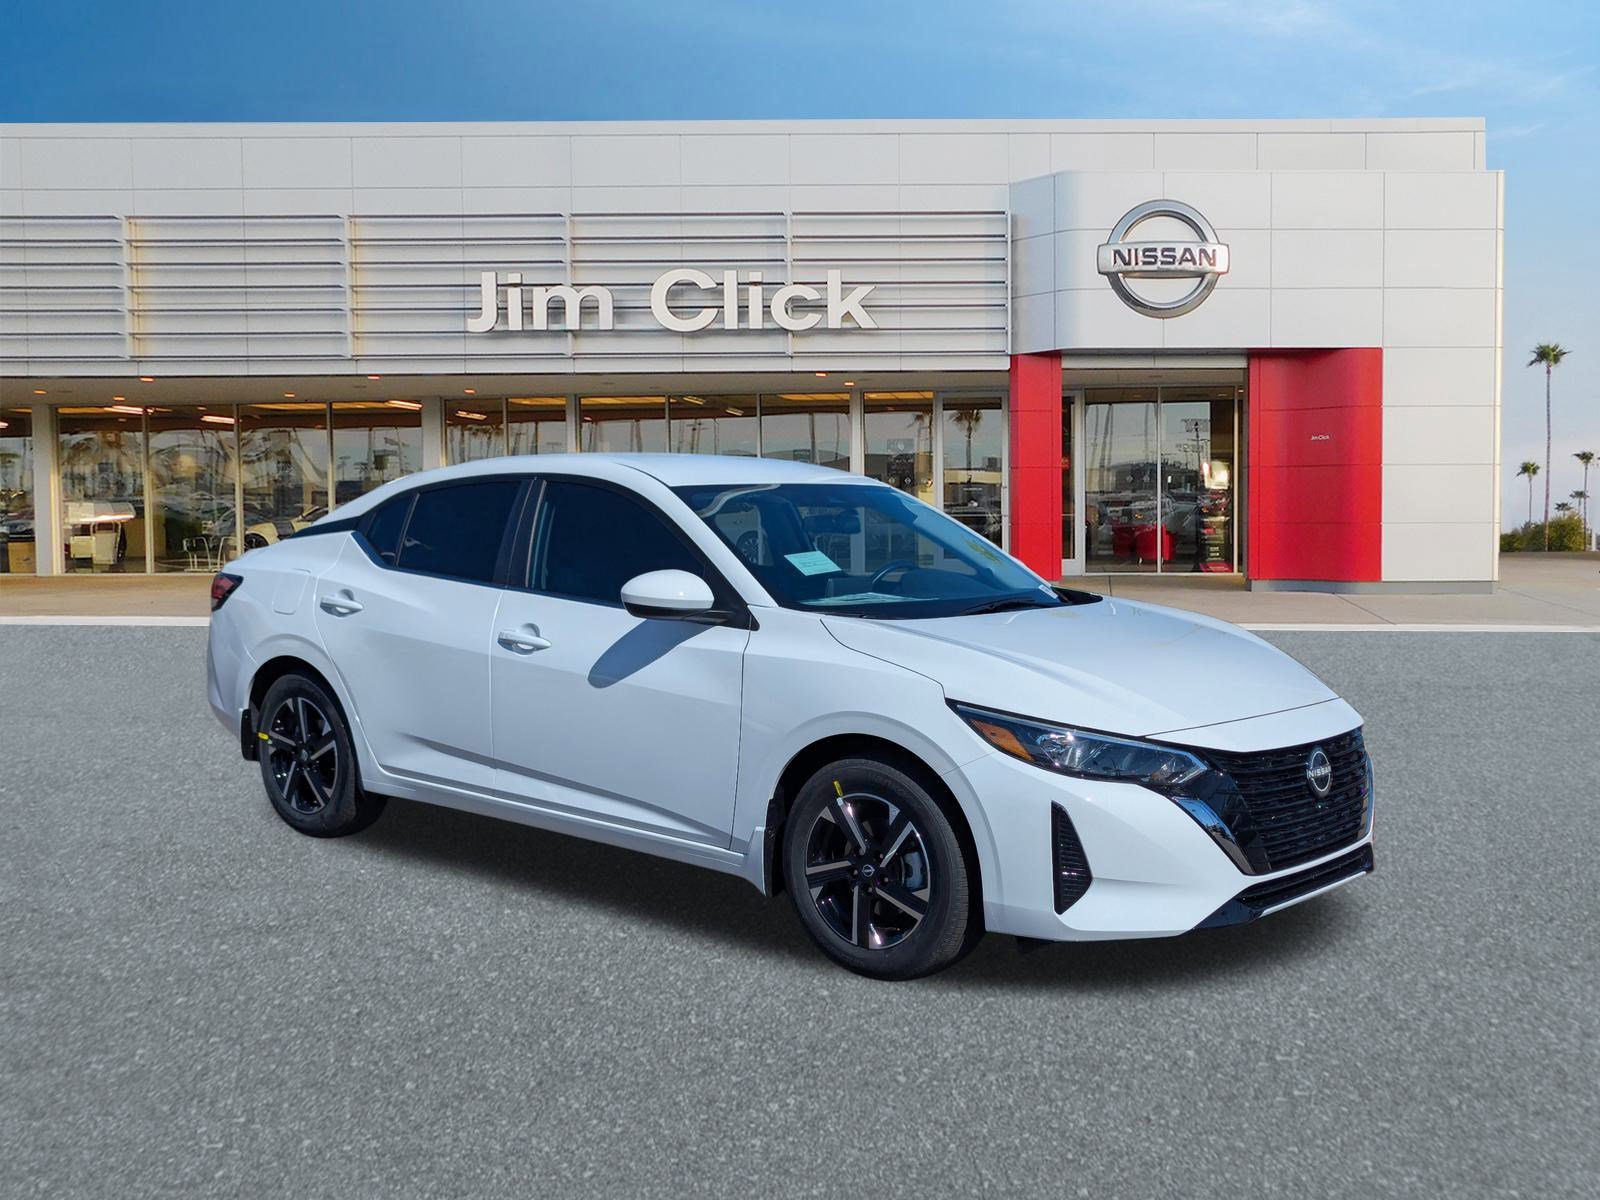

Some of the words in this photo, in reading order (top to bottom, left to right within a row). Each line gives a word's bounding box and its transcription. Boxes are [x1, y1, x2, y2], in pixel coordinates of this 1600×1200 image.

[1112, 247, 1217, 267] NISSAN
[467, 271, 614, 333] Jim
[650, 268, 880, 333] Click
[1308, 766, 1331, 778] NISSAN
